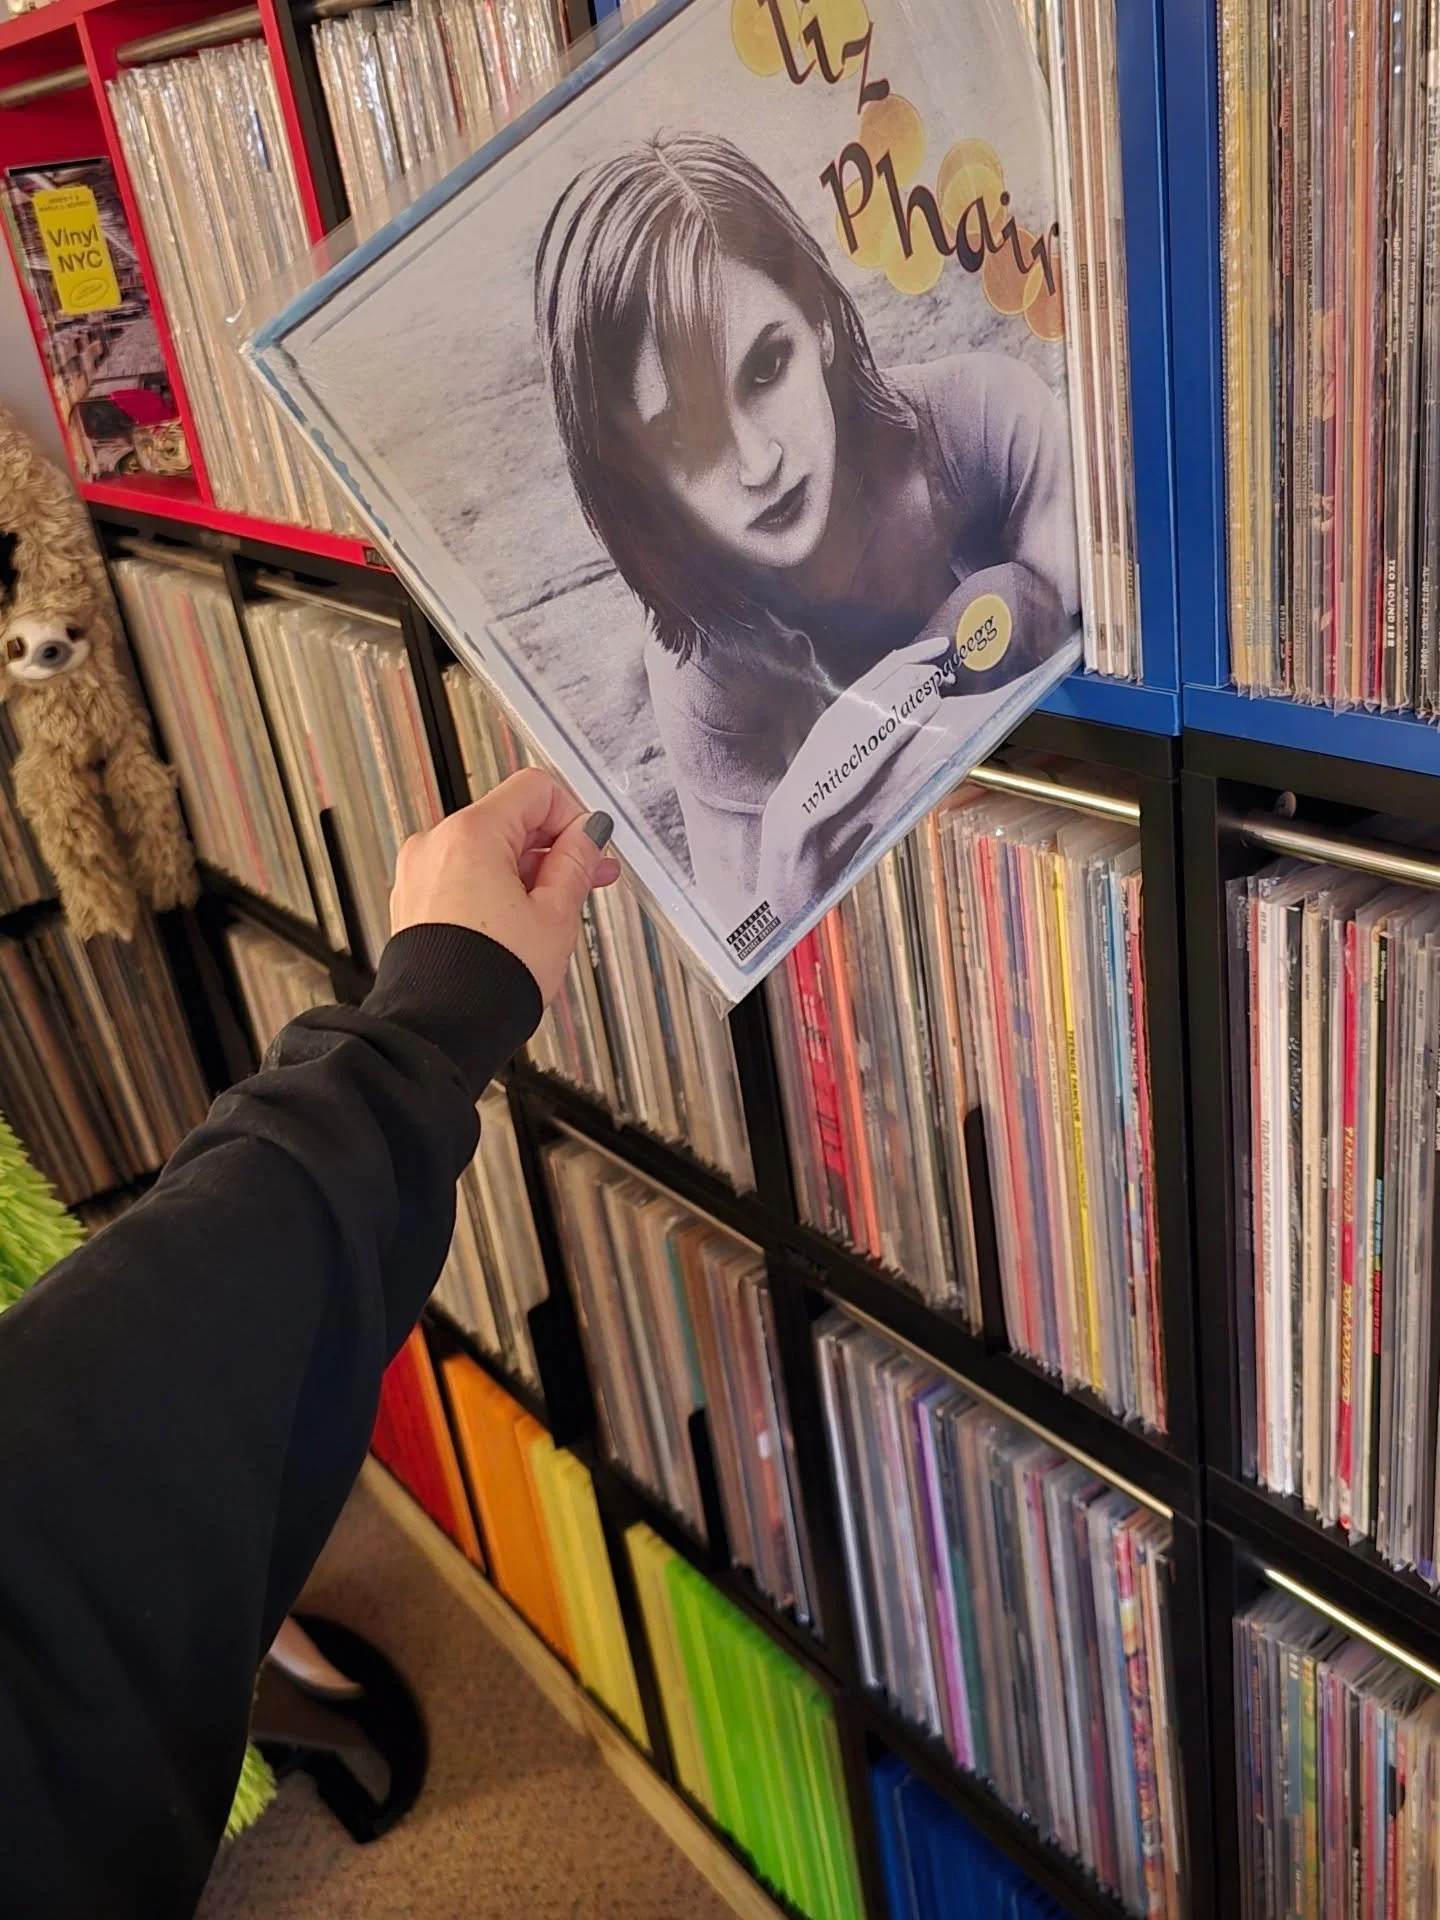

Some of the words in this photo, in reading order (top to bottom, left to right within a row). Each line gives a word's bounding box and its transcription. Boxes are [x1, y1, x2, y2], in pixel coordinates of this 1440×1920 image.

[48, 223, 99, 248] Vinyl
[58, 250, 103, 273] NYC
[1388, 559, 1396, 580] TKO
[1387, 583, 1396, 623] ROUND
[802, 615, 998, 815] whitechocolatespaceegg
[733, 909, 774, 953] ADVISORY
